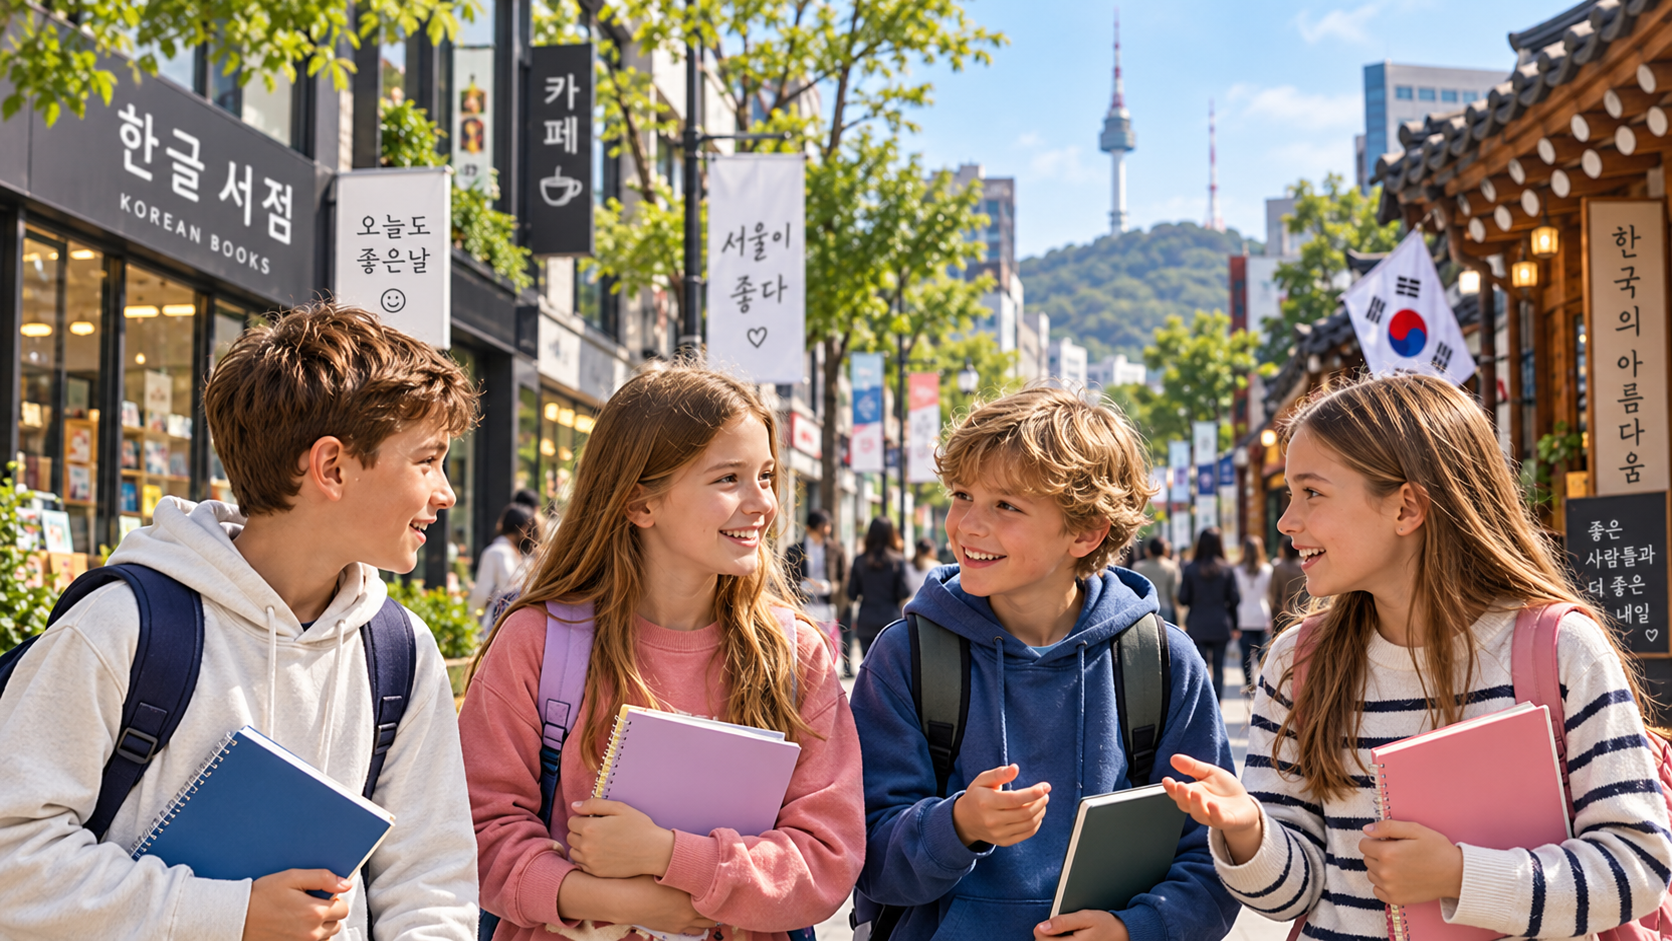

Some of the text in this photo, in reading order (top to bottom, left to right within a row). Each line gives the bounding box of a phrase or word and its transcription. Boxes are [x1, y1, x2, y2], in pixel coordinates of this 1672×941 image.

[544, 73, 581, 155] 카페
[117, 103, 293, 246] 한글 서점
[119, 192, 271, 275] KOREAN BOOKS
[356, 214, 431, 240] 오늘도
[721, 221, 791, 263] 서울이
[729, 273, 789, 315] 좋다
[1611, 224, 1646, 485] 한국의 아름다움
[1587, 519, 1623, 542] 좋은
[1588, 574, 1646, 598] 더 좋은
[1616, 602, 1650, 625] 내일
